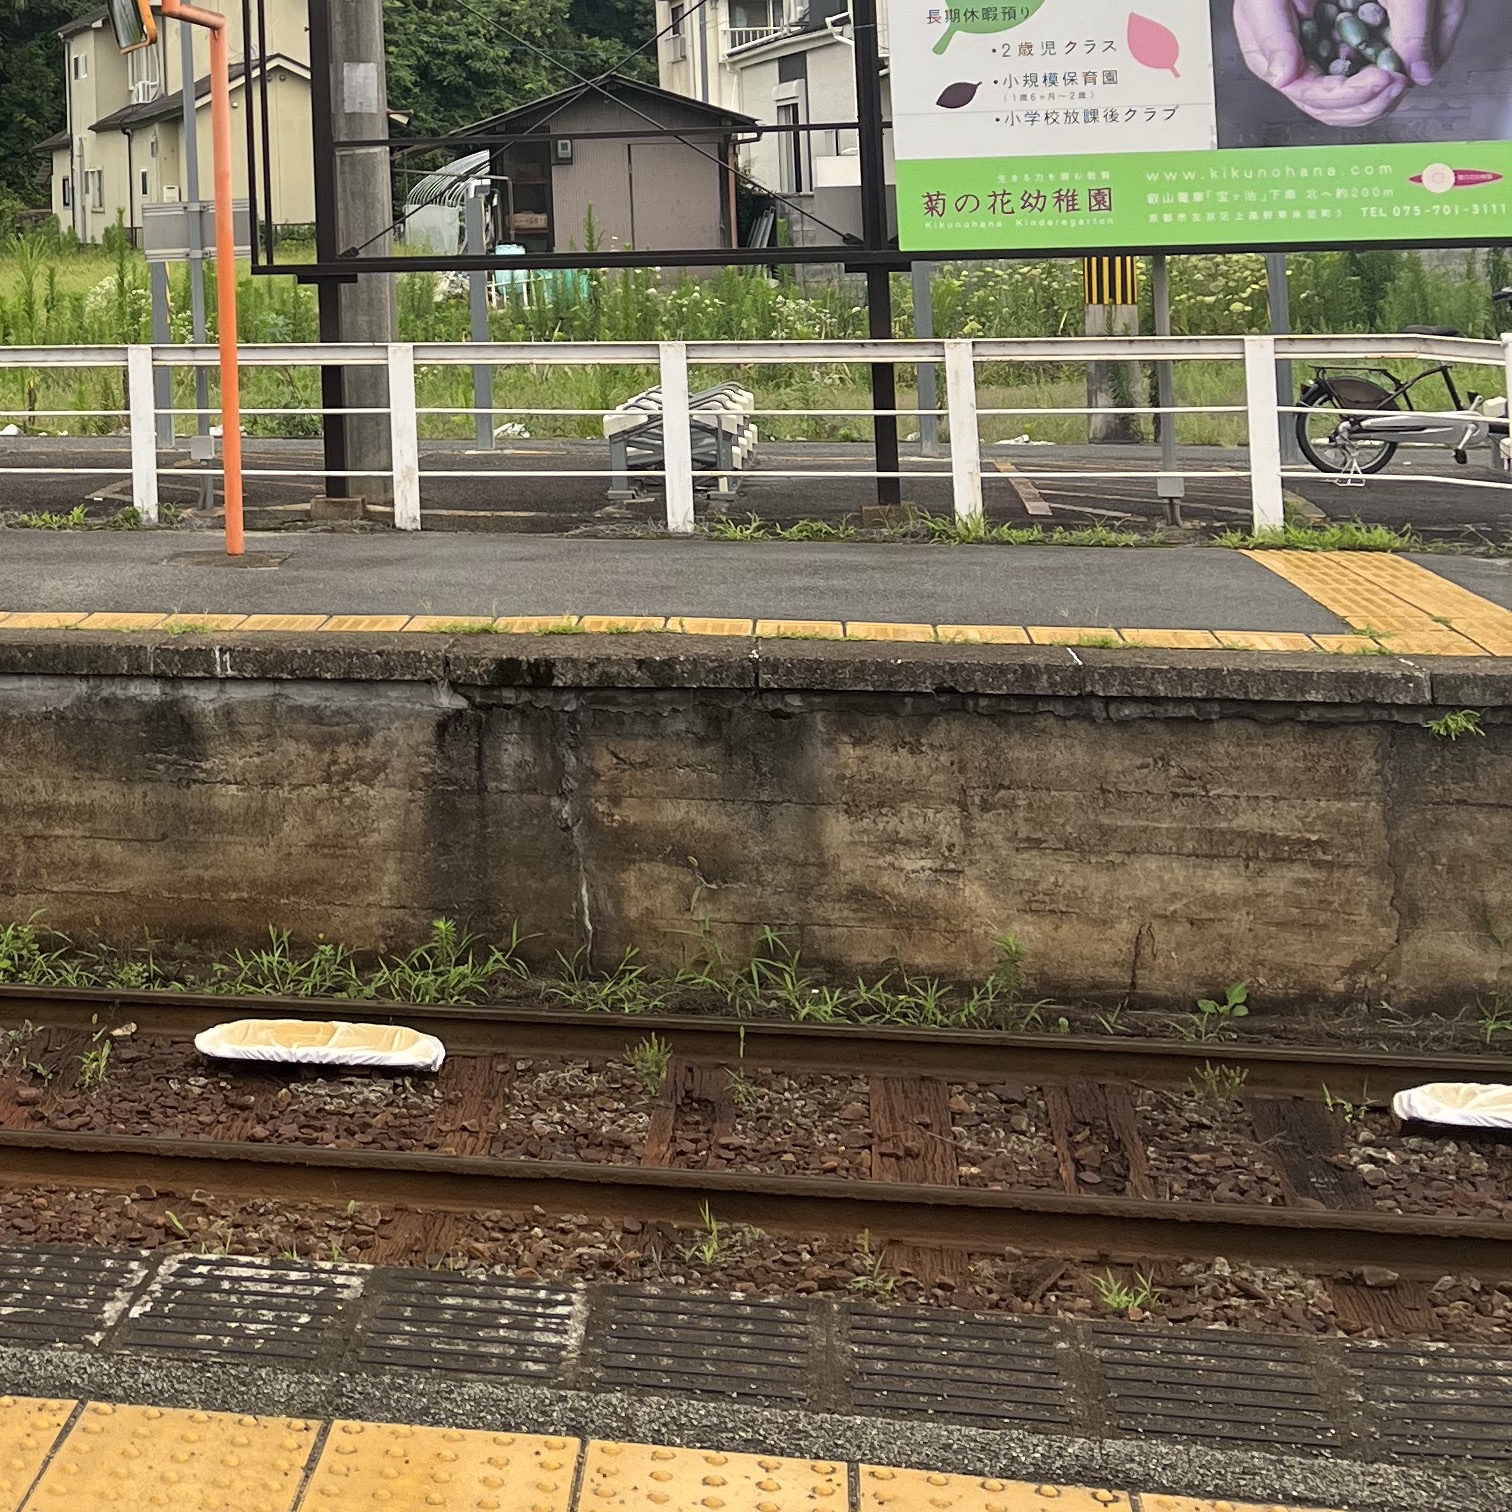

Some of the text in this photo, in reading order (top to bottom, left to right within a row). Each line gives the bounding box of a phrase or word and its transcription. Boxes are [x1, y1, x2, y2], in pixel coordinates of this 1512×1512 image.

[926, 5, 1031, 25] 長期休暇預り
[1145, 165, 1393, 181] www.kikunohana.com
[921, 187, 1113, 218] 菊の花幼稚園
[1360, 203, 1507, 218] TEL 075-701-3111
